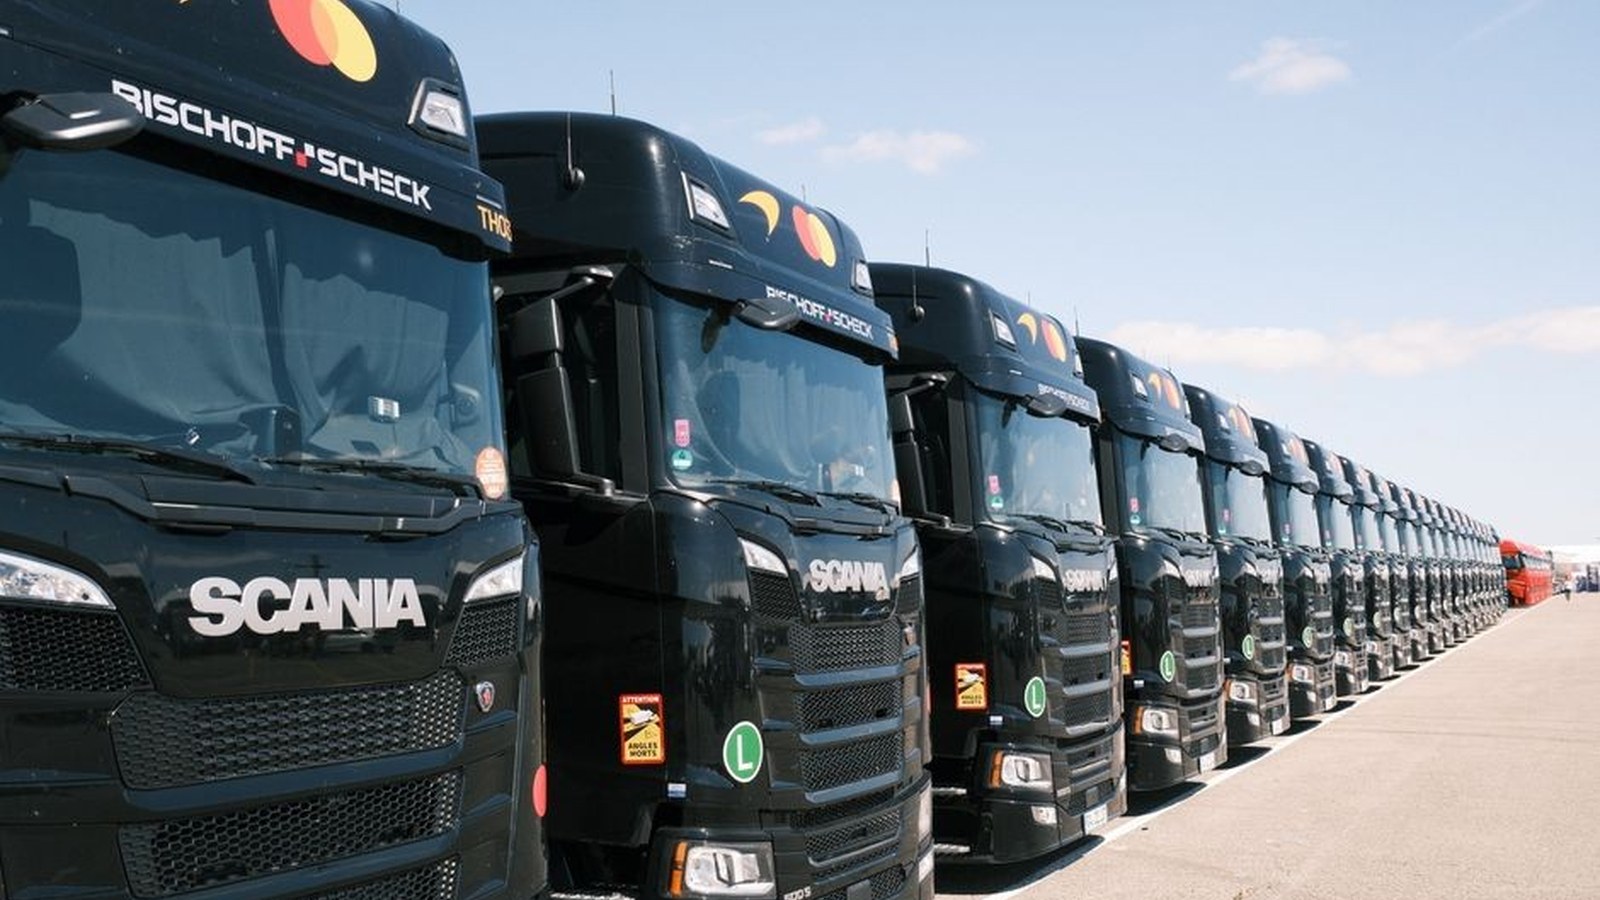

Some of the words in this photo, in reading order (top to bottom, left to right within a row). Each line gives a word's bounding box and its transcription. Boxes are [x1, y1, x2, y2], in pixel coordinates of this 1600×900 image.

[316, 147, 432, 211] SCHECK
[808, 558, 890, 594] SCANIA
[187, 576, 427, 637] SCANIA
[1032, 684, 1041, 709] L
[628, 741, 658, 749] ANGLES
[629, 749, 657, 758] MORTS
[736, 734, 754, 771] L
